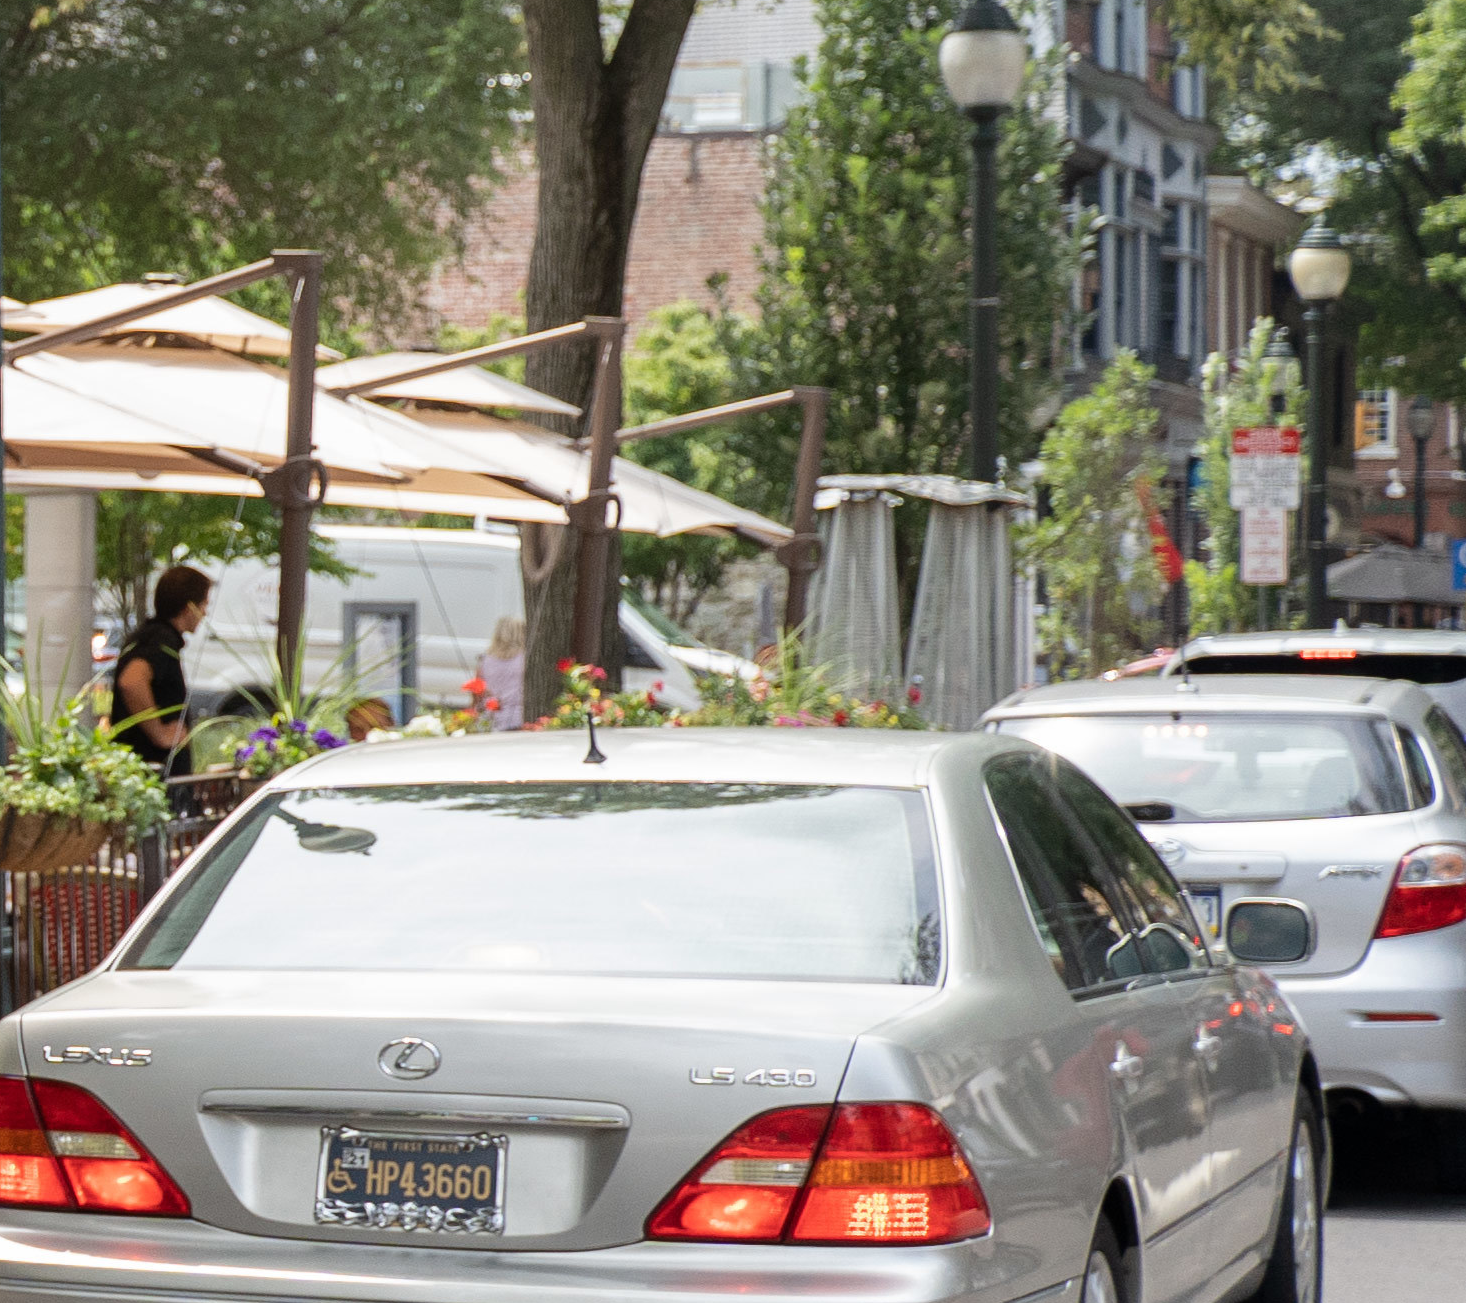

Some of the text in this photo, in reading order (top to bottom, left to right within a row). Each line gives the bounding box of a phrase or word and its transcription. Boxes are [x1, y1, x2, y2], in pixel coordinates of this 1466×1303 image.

[43, 1045, 152, 1066] LEXUS
[690, 1066, 817, 1087] LS 430
[367, 1139, 460, 1154] THE FIRST STATE
[365, 1159, 492, 1200] HP43660
